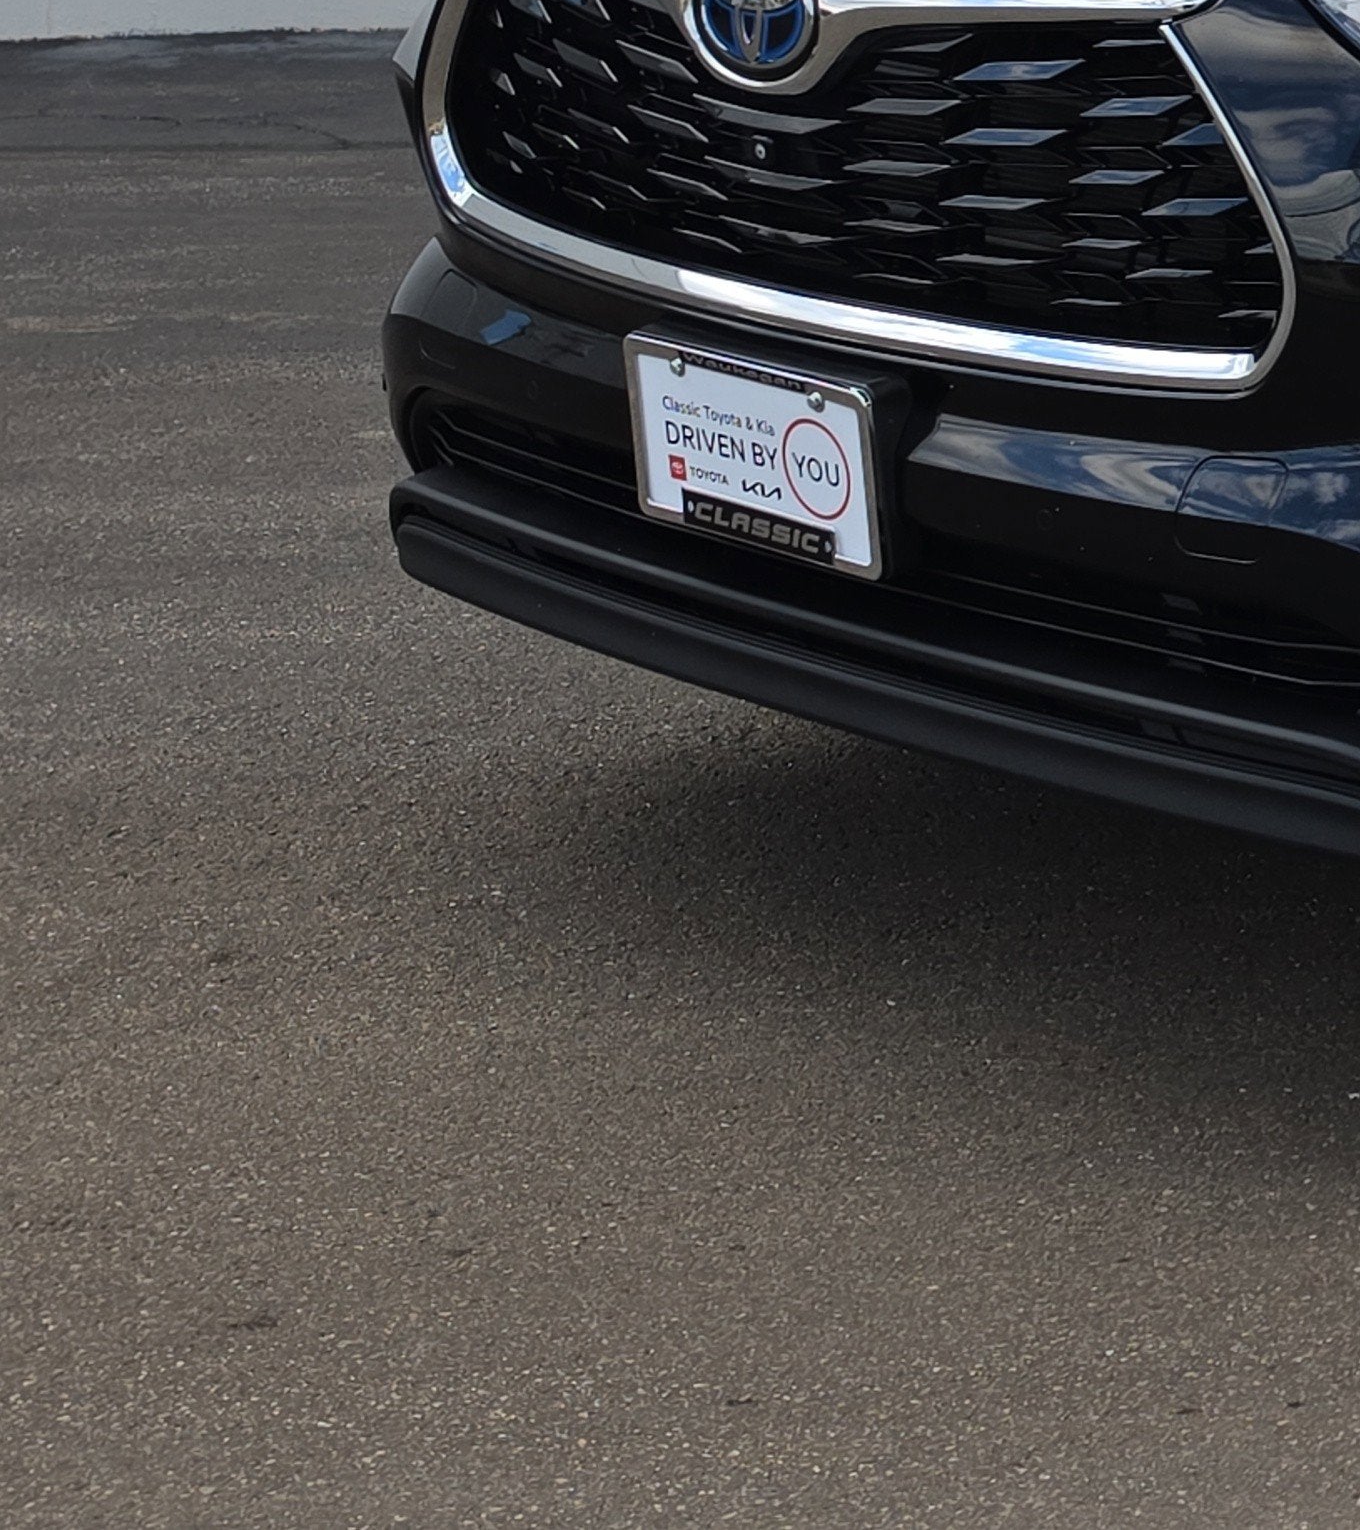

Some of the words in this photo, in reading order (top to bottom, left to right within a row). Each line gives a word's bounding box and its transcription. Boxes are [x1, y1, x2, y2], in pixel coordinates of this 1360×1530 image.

[681, 352, 802, 390] Waukegan
[662, 395, 701, 418] Classic
[703, 405, 743, 426] Toyota
[745, 416, 753, 431] &
[665, 421, 745, 463] DRIVEN
[752, 442, 778, 470] BY
[792, 452, 840, 487] YOU
[690, 466, 729, 486] TOYOTA
[694, 502, 820, 553] CLASSIC
